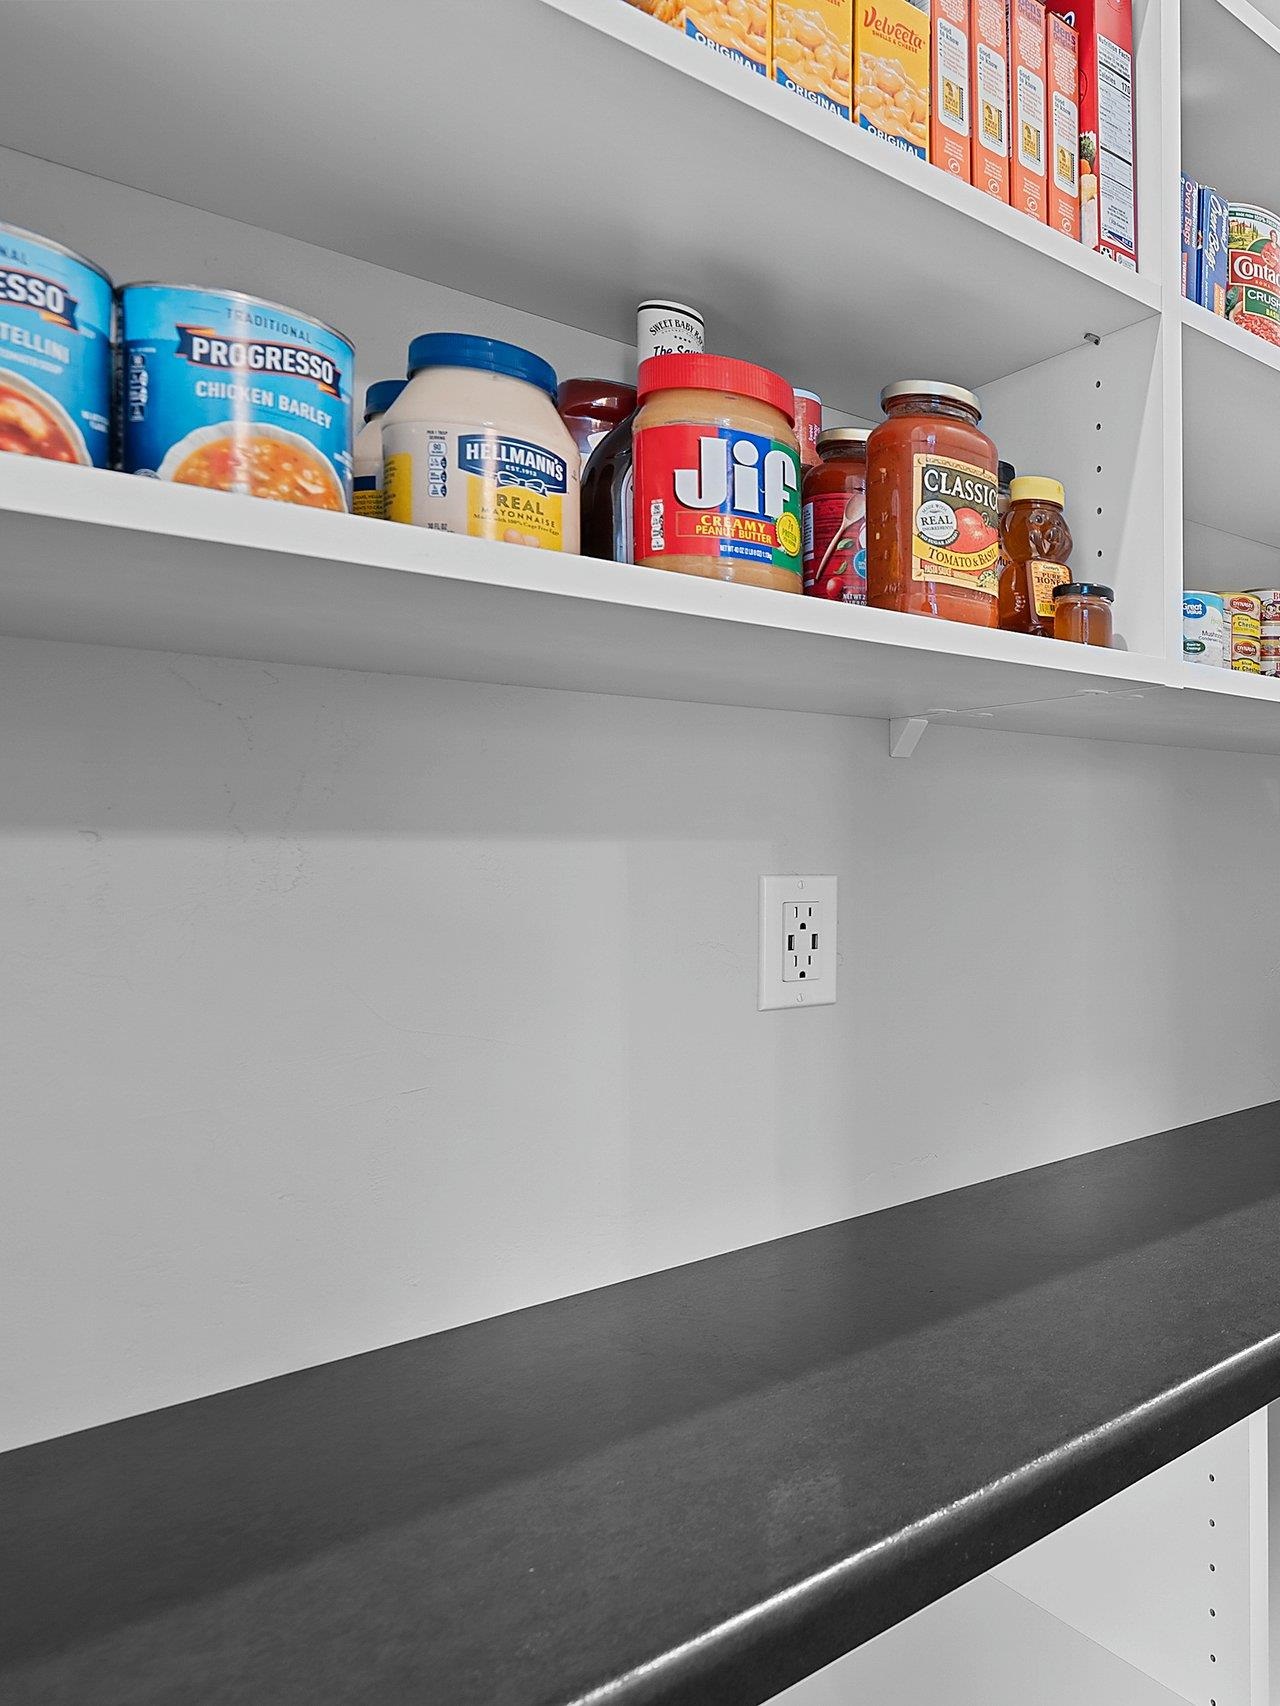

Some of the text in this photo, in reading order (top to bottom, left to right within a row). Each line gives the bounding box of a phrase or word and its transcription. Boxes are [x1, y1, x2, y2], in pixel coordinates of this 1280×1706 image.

[863, 6, 924, 50] Velveeta
[1053, 20, 1076, 45] Ben's
[694, 31, 758, 73] ORIGINAL
[785, 79, 844, 120] ORIGINAL
[867, 125, 921, 158] ORIGINAL
[1183, 181, 1193, 246] Oven Bags
[1204, 194, 1223, 272] Oven Bags
[226, 307, 312, 344] TRADITIONAL
[649, 319, 673, 336] SWEET
[674, 319, 694, 333] BABY
[191, 337, 334, 386] PROGRESSO
[653, 345, 673, 357] The
[194, 380, 275, 408] CHICKEN
[278, 395, 333, 430] BARLEY
[465, 442, 564, 482] HELLMANN'S
[673, 436, 798, 519] Jif
[496, 493, 544, 516] REAL
[923, 468, 999, 514] CLASSIC
[695, 524, 736, 538] PEANUT
[738, 529, 773, 545] BUTTER
[701, 514, 766, 534] CREAMY
[920, 515, 954, 526] REAL
[929, 547, 972, 568] TOMATO
[1183, 602, 1202, 611] Great
